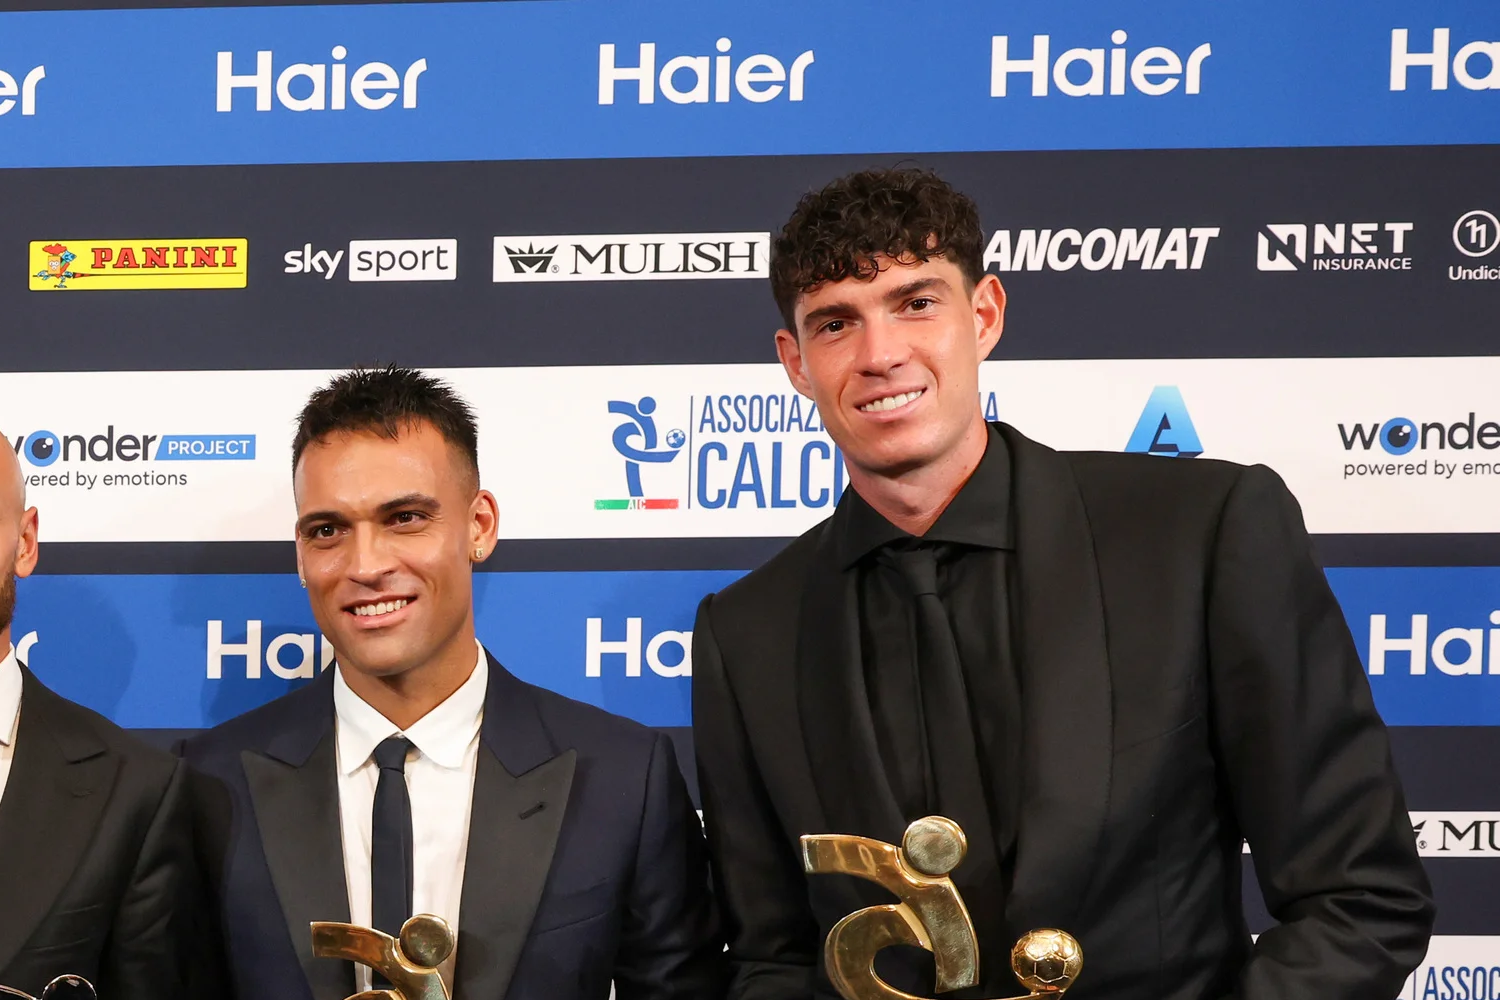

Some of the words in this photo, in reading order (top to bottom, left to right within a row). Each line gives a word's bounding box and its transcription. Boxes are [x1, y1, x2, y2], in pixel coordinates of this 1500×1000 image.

[216, 45, 426, 112] Haier
[598, 37, 814, 104] Haier
[990, 29, 1211, 97] Haier
[90, 243, 239, 271] PANINI
[984, 227, 1220, 271] ANCOMAT
[1313, 222, 1414, 255] NET
[284, 243, 344, 280] sky
[356, 243, 449, 278] sport
[570, 241, 759, 275] MULISH
[1313, 257, 1412, 271] INSURANCE
[167, 439, 251, 456] PROJECT
[1337, 412, 1500, 456] wonde
[25, 471, 71, 487] ered
[75, 470, 98, 489] by
[103, 470, 187, 486] emotions
[698, 441, 845, 510] CALCI
[1344, 460, 1428, 479] powered
[1434, 460, 1457, 479] by
[1369, 613, 1500, 676] Hai
